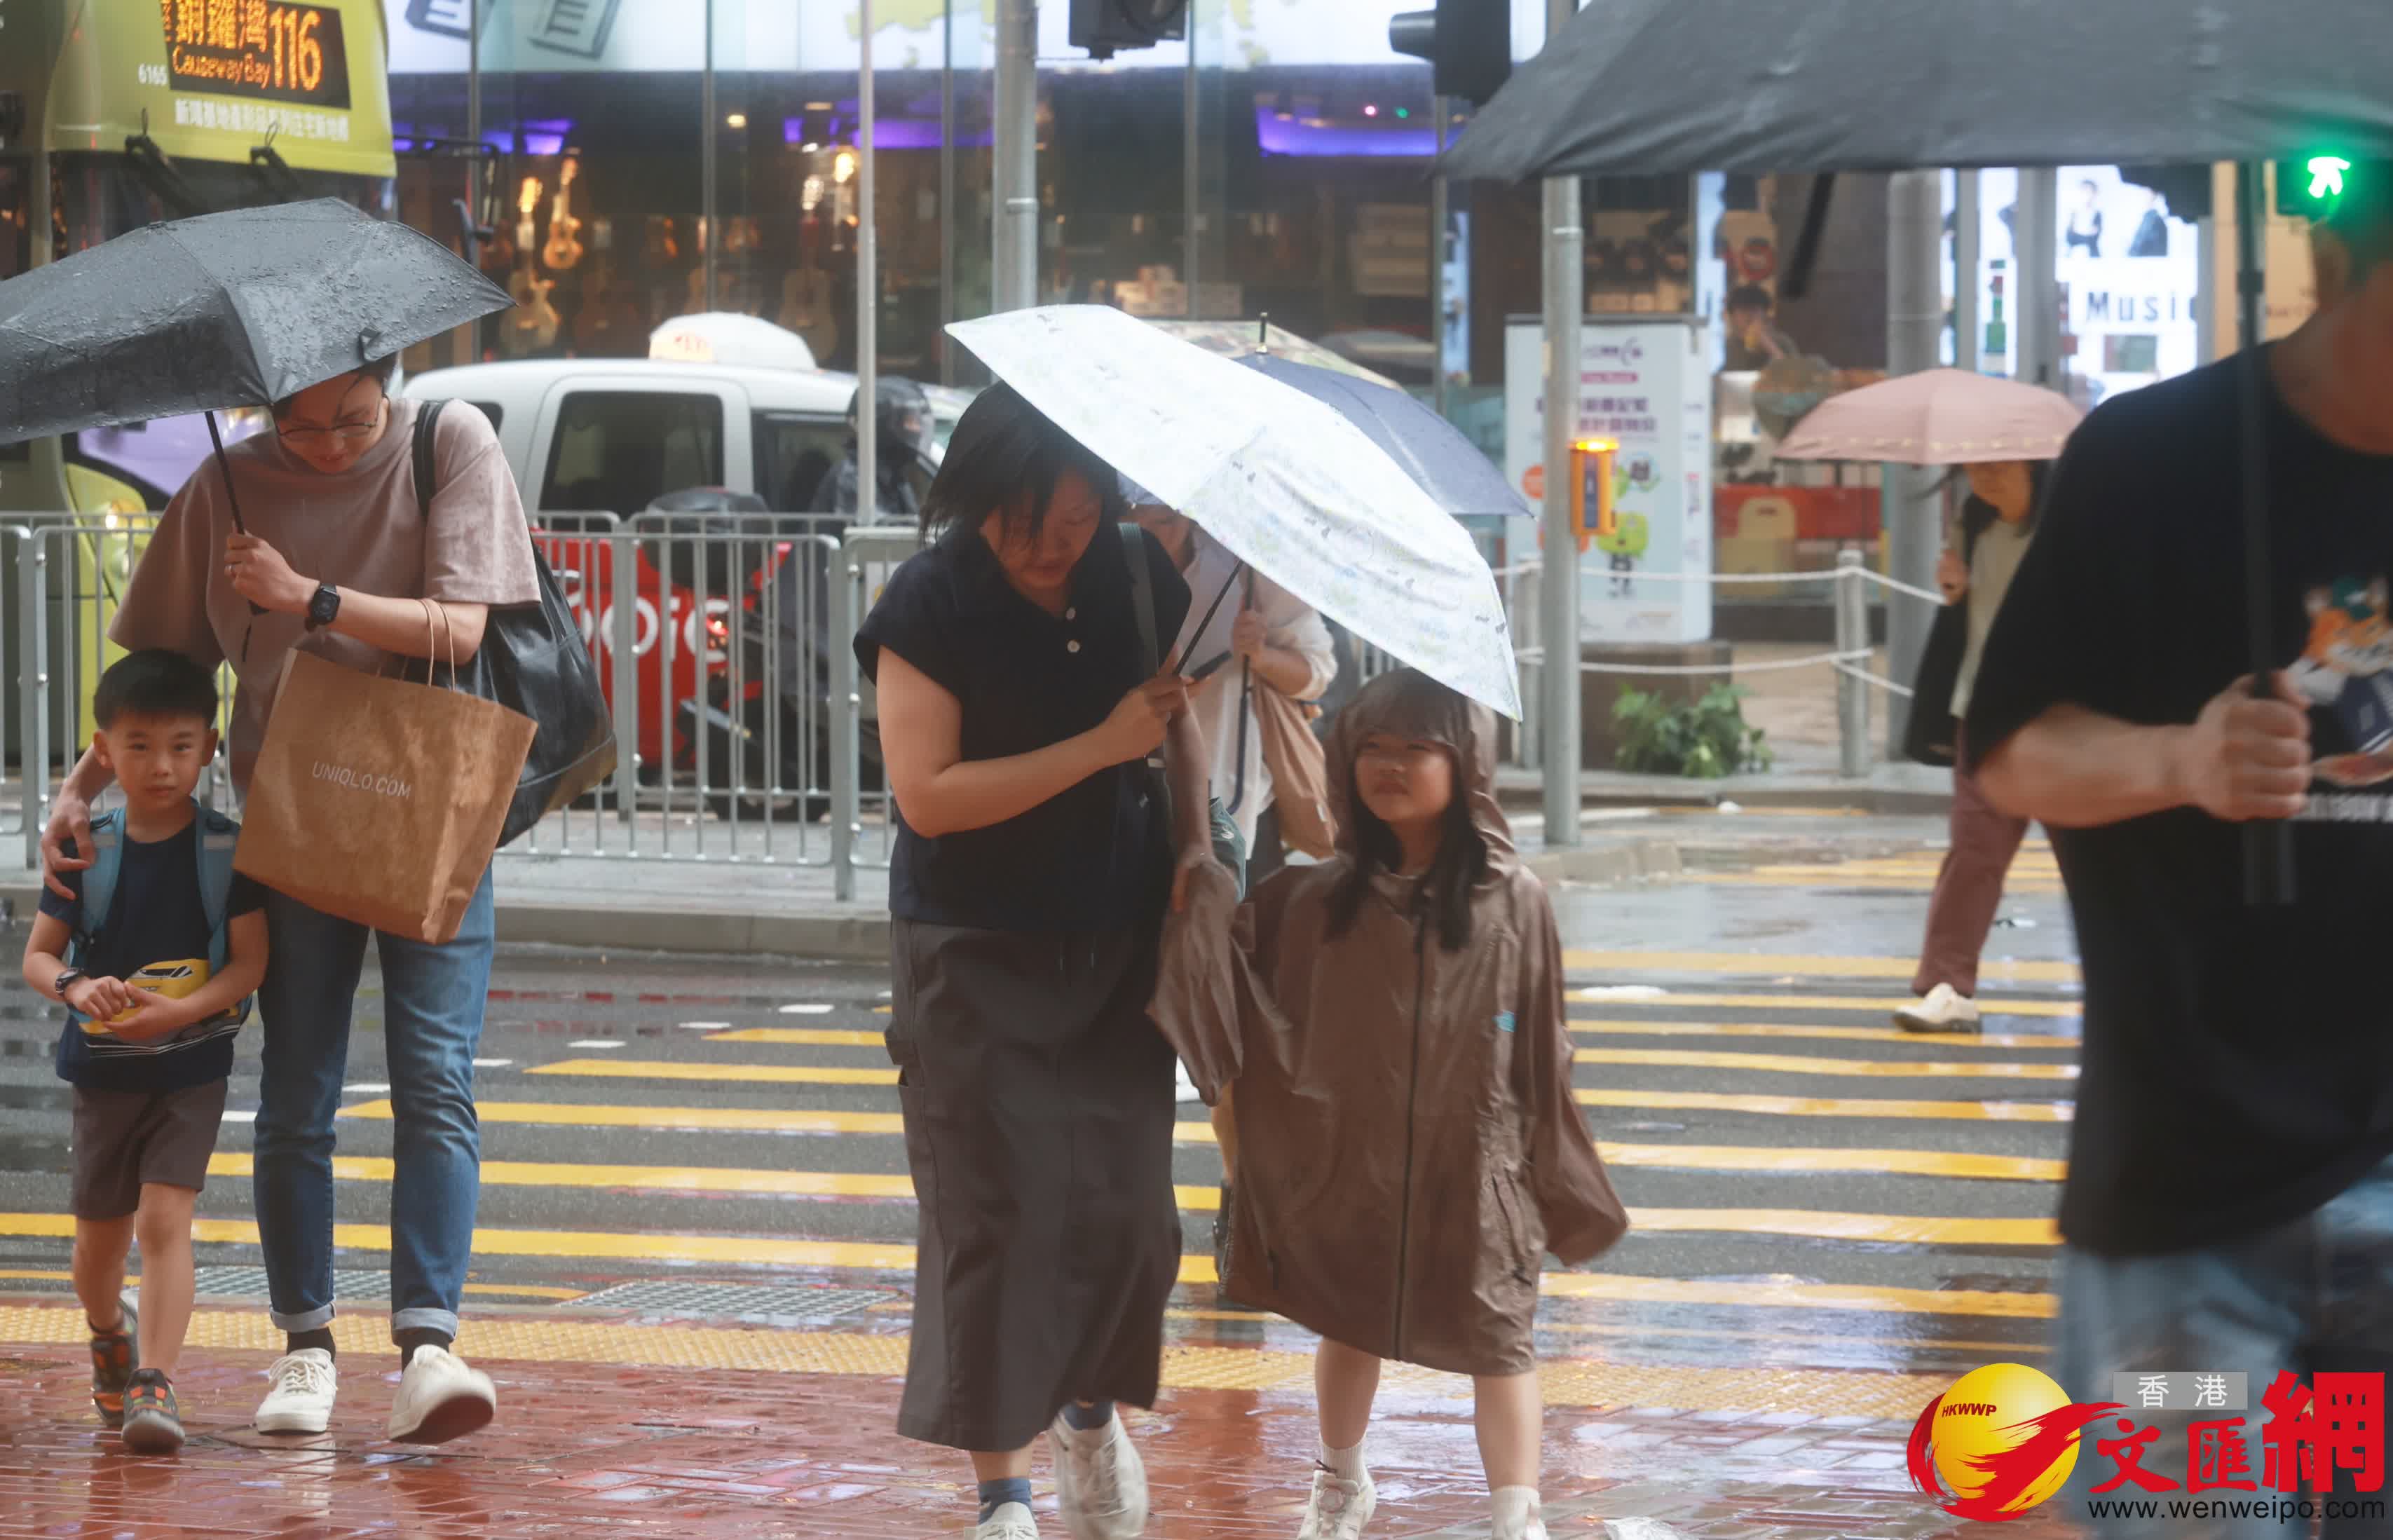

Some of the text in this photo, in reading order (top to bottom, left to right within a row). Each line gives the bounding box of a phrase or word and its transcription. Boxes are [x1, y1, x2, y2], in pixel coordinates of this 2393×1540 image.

[172, 45, 271, 90] Causeway Bay
[270, 6, 323, 91] 116
[313, 761, 411, 799] UNIQLO.COM
